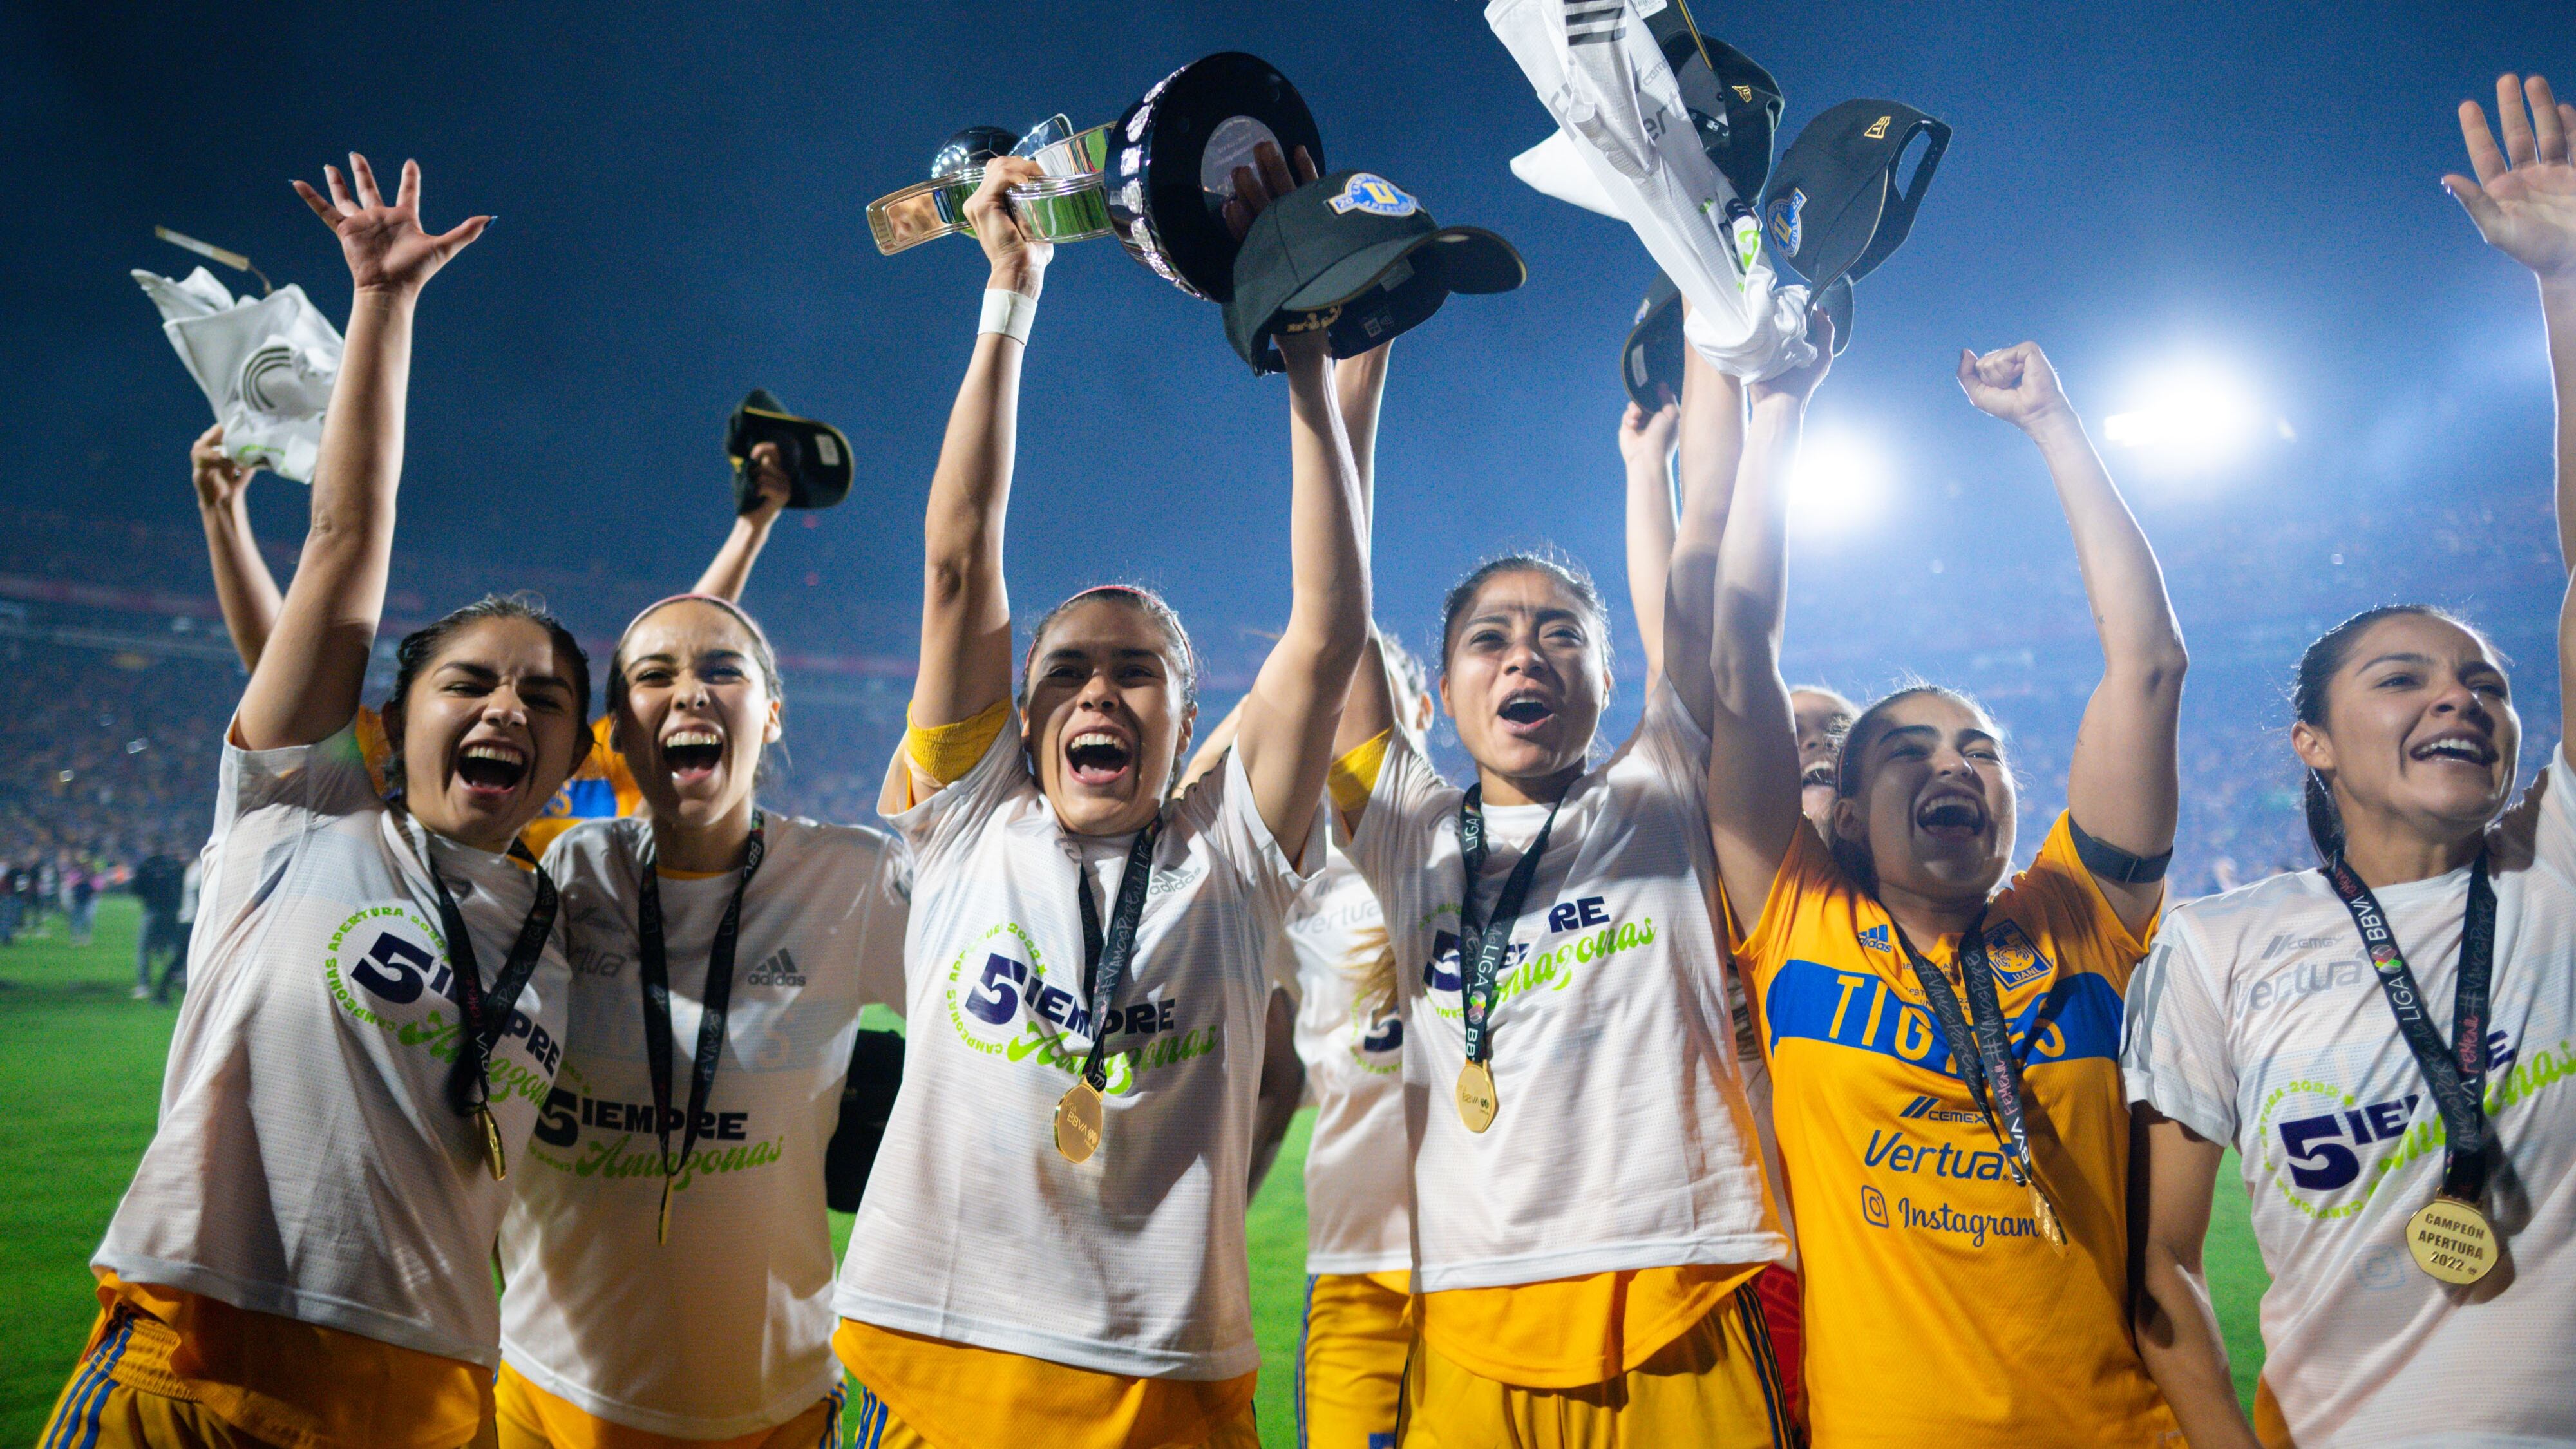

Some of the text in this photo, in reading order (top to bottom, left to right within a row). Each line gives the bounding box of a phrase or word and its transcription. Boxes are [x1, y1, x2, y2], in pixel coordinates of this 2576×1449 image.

[1792, 196, 1801, 211] 22
[1465, 818, 1480, 851] LIGA
[743, 840, 762, 878] BBV
[1148, 867, 1202, 895] adidas
[328, 907, 404, 952] APERTURA
[2351, 895, 2387, 942] BBVA
[1007, 922, 1041, 960] 2022
[748, 971, 806, 987] adidas
[1474, 944, 1499, 987] LIGA
[2012, 966, 2041, 980] UANL
[2234, 961, 2363, 1019] Vertua
[2388, 976, 2421, 1021] LIGA
[1829, 974, 2066, 1074] TIGS
[1466, 1028, 1479, 1057] BB
[1993, 1059, 2019, 1117] FEMENIL
[2289, 1079, 2340, 1099] 2022
[1067, 1111, 1088, 1136] BBVA
[1928, 1109, 1988, 1124] CEMEX
[1864, 1129, 2003, 1182] Vertua
[2011, 1117, 2029, 1164] BVA
[1898, 1197, 2040, 1247] Instagram
[2425, 1213, 2485, 1240] CAMPEÓN
[2418, 1229, 2484, 1260] APERTURA
[2429, 1251, 2465, 1272] 2022
